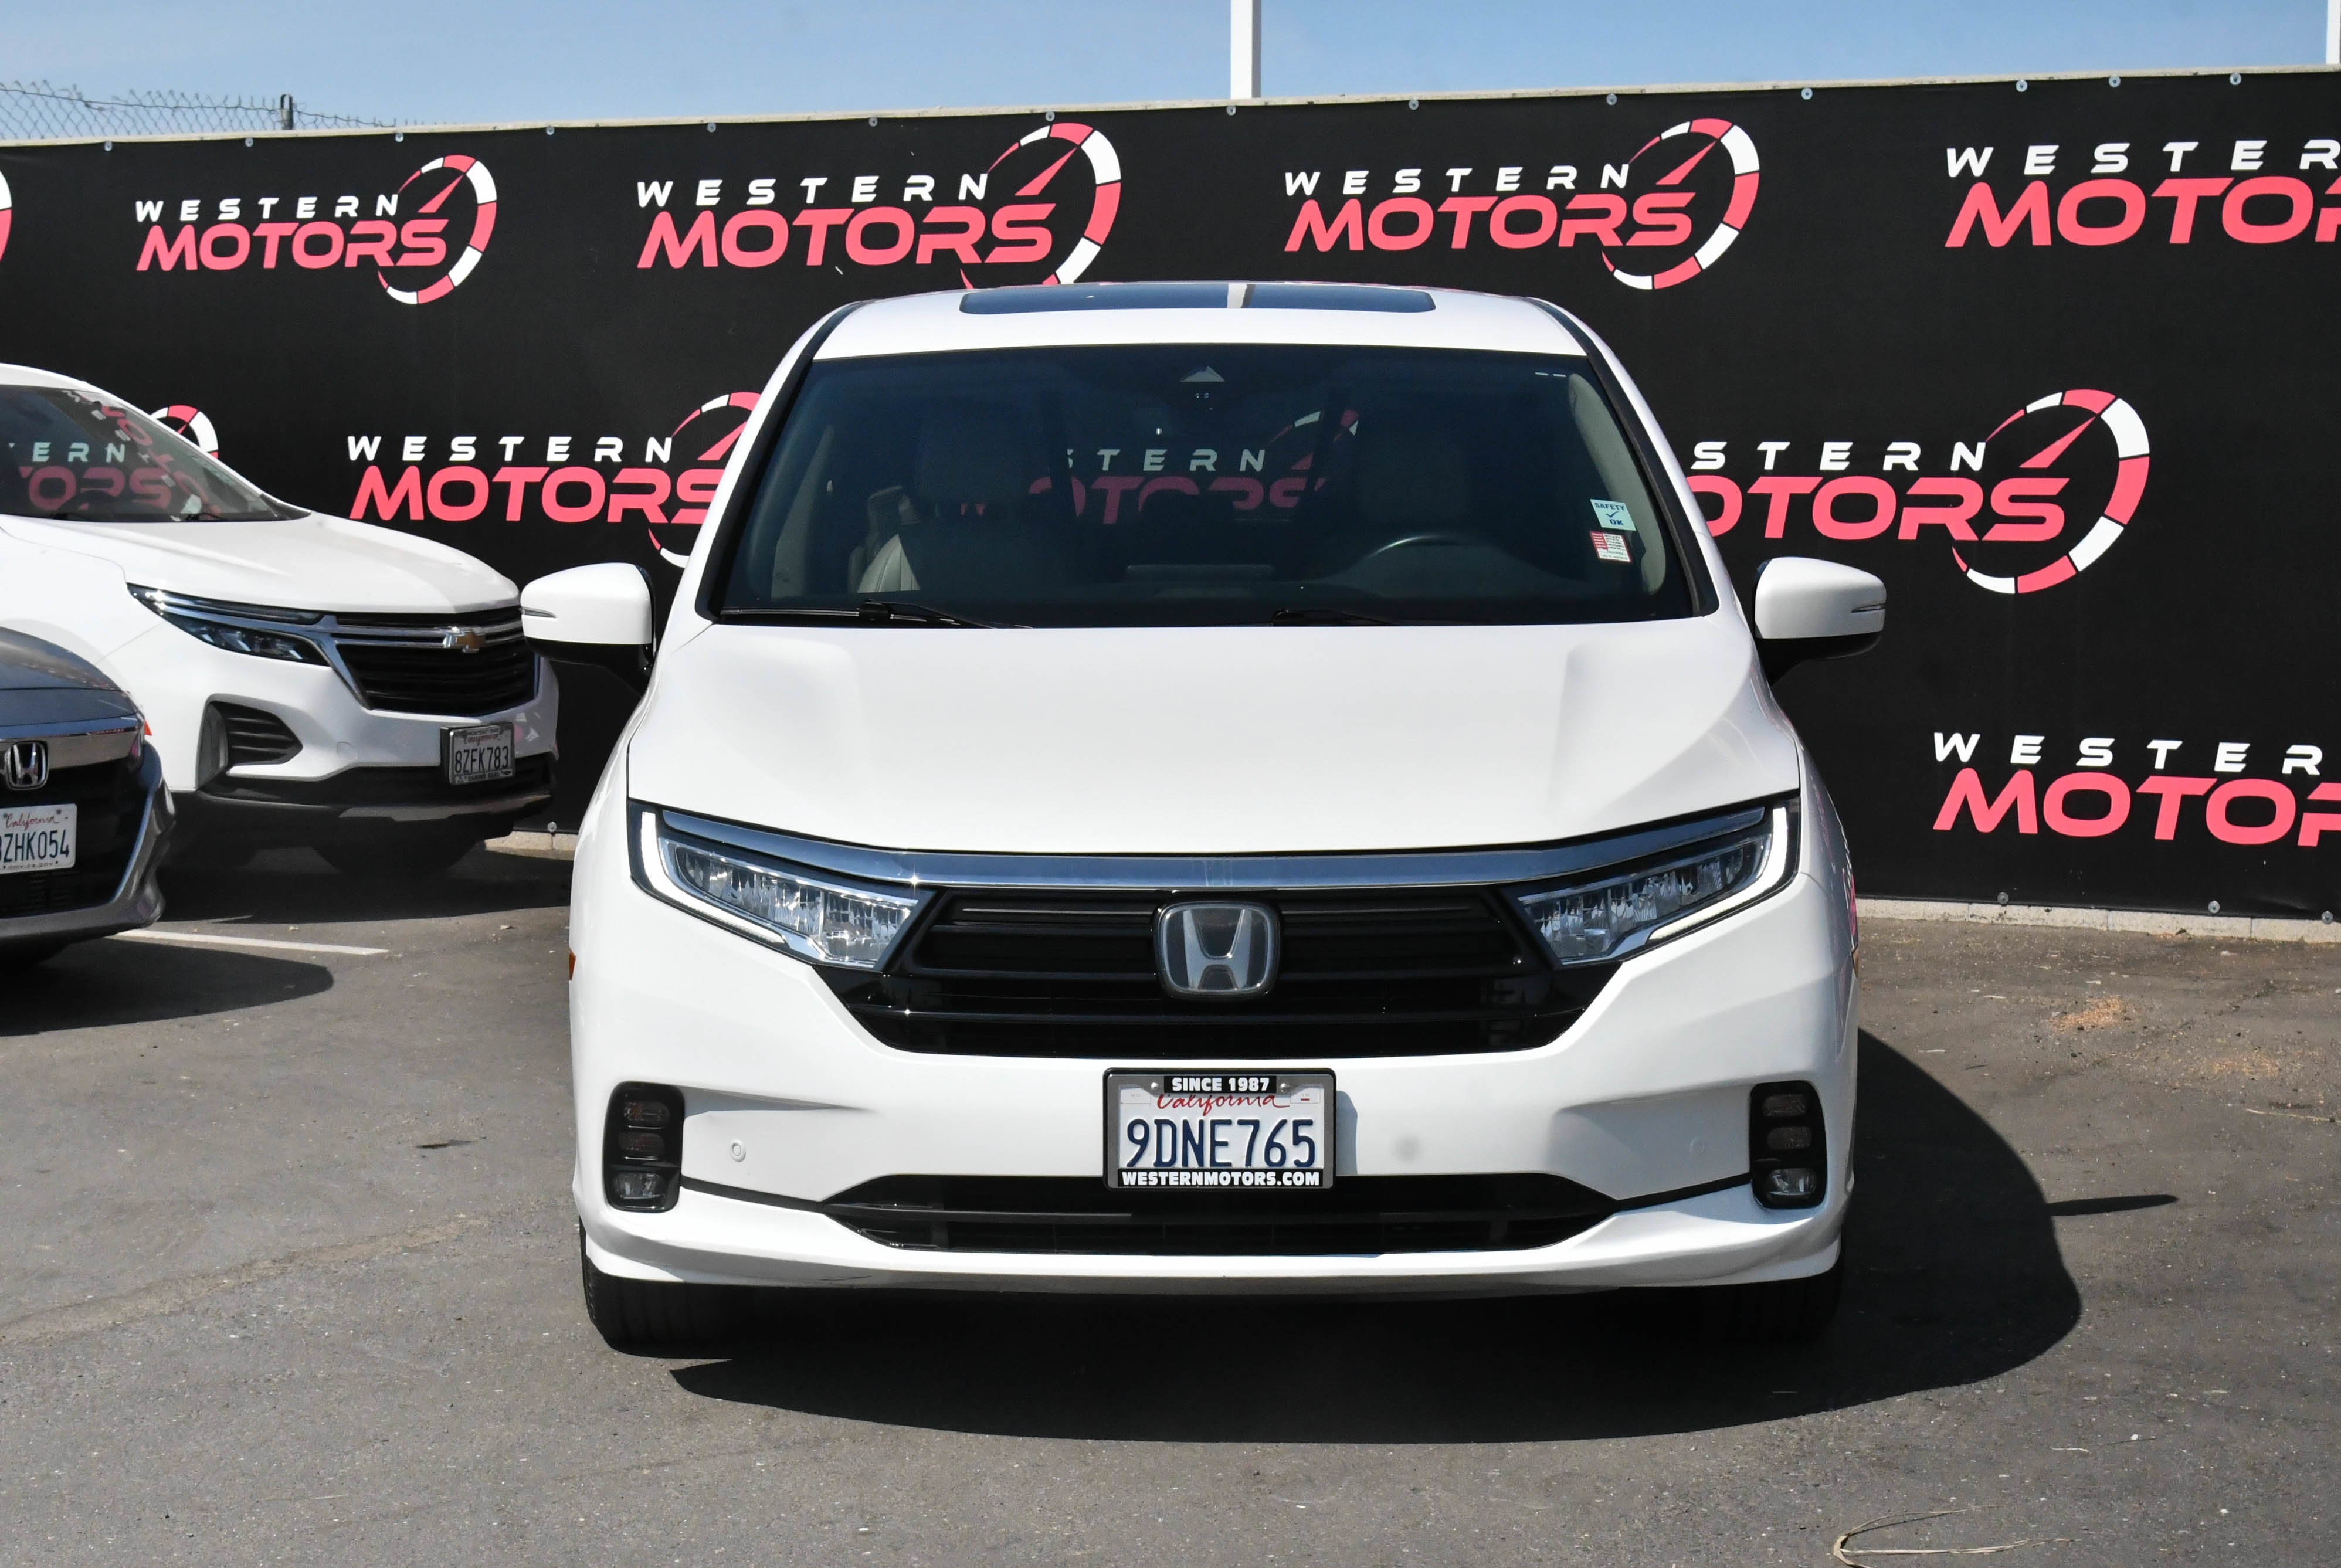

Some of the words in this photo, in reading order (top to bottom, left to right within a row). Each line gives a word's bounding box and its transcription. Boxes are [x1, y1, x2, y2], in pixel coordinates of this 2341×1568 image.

[637, 174, 988, 208] WESTERN
[1285, 163, 1630, 196] WESTERN
[135, 194, 399, 222] WESTERN
[1284, 192, 1696, 252] MOTORS
[1945, 175, 2341, 247] MOTO
[135, 219, 449, 271] MOTORS
[637, 203, 1056, 269] MOTORS
[347, 436, 673, 463] WESTERN
[1594, 503, 1624, 511] SAFETY
[454, 746, 508, 773] 8ZFK783
[1933, 732, 2323, 775] WESTER
[6, 813, 59, 830] California
[0, 829, 69, 863] ZHK054
[1172, 1077, 1222, 1091] SINCE
[1229, 1077, 1269, 1091] 1987
[1126, 1118, 1315, 1167] 9DNE765
[1122, 1171, 1320, 1186] WESTERNMOTORS.COM
